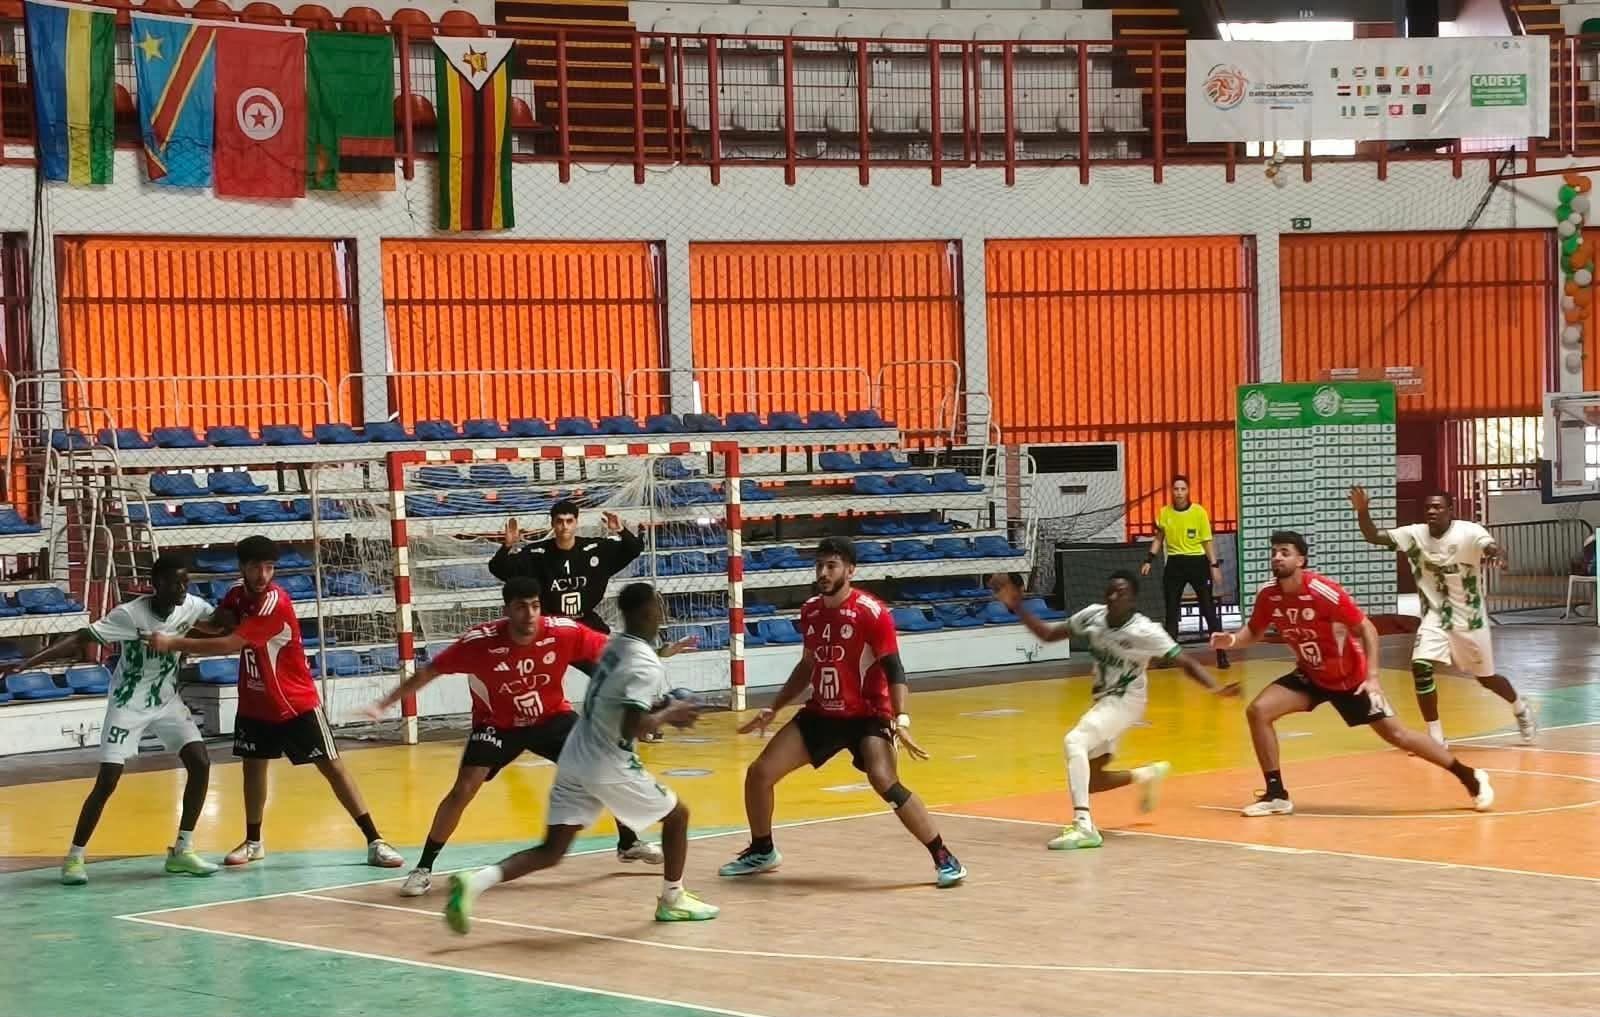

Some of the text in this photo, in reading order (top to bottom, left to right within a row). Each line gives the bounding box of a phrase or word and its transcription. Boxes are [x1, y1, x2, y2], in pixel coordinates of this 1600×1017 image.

[1472, 75, 1520, 87] CADETS
[563, 559, 571, 575] 1
[822, 623, 831, 643] 4
[516, 658, 535, 677] 10
[107, 726, 130, 745] 97
